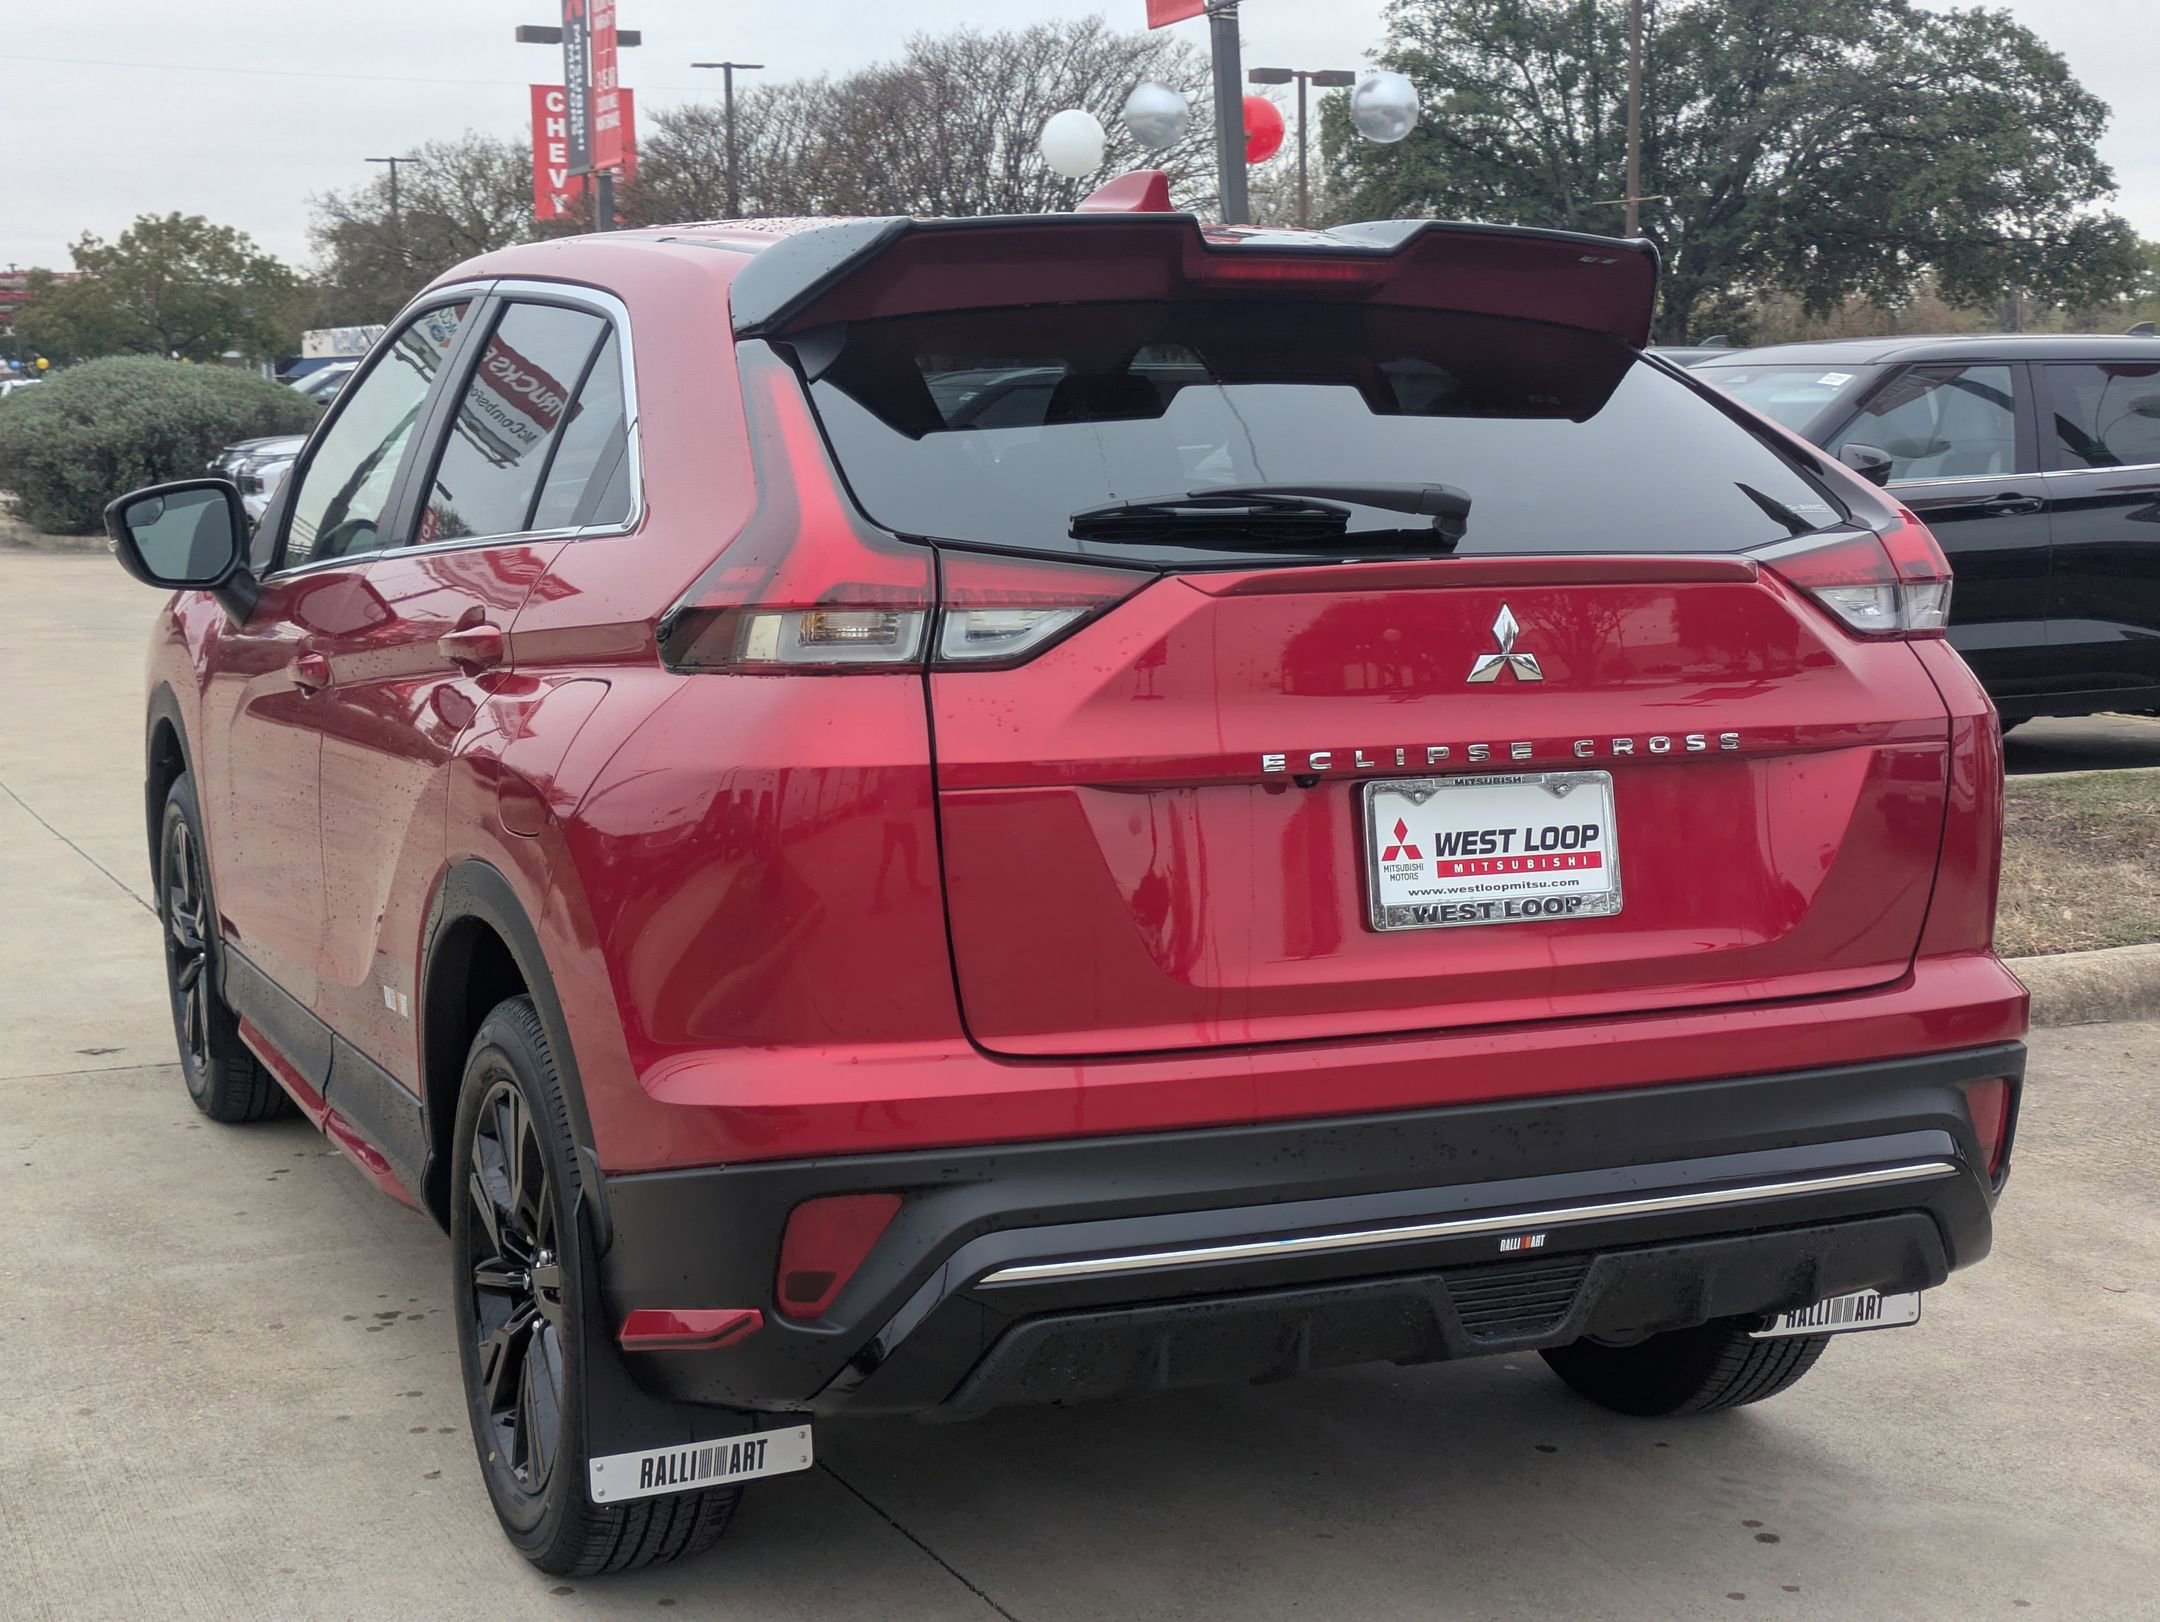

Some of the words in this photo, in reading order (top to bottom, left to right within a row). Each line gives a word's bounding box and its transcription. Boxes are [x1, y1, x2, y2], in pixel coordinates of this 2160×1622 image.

[545, 91, 568, 214] CHEVY
[1262, 741, 1533, 773] ECLIPSE
[1573, 732, 1740, 759] CROSS
[1435, 829, 1516, 857] WEST
[1523, 824, 1600, 852] LOOP
[1383, 863, 1424, 873] MITSUBISHI
[1390, 872, 1419, 881] MOTORS
[1454, 857, 1587, 873] MITSUBISHI
[1408, 878, 1580, 897] www.westloopmitsu.com
[1413, 901, 1495, 923] WEST
[1504, 896, 1582, 918] LOOP
